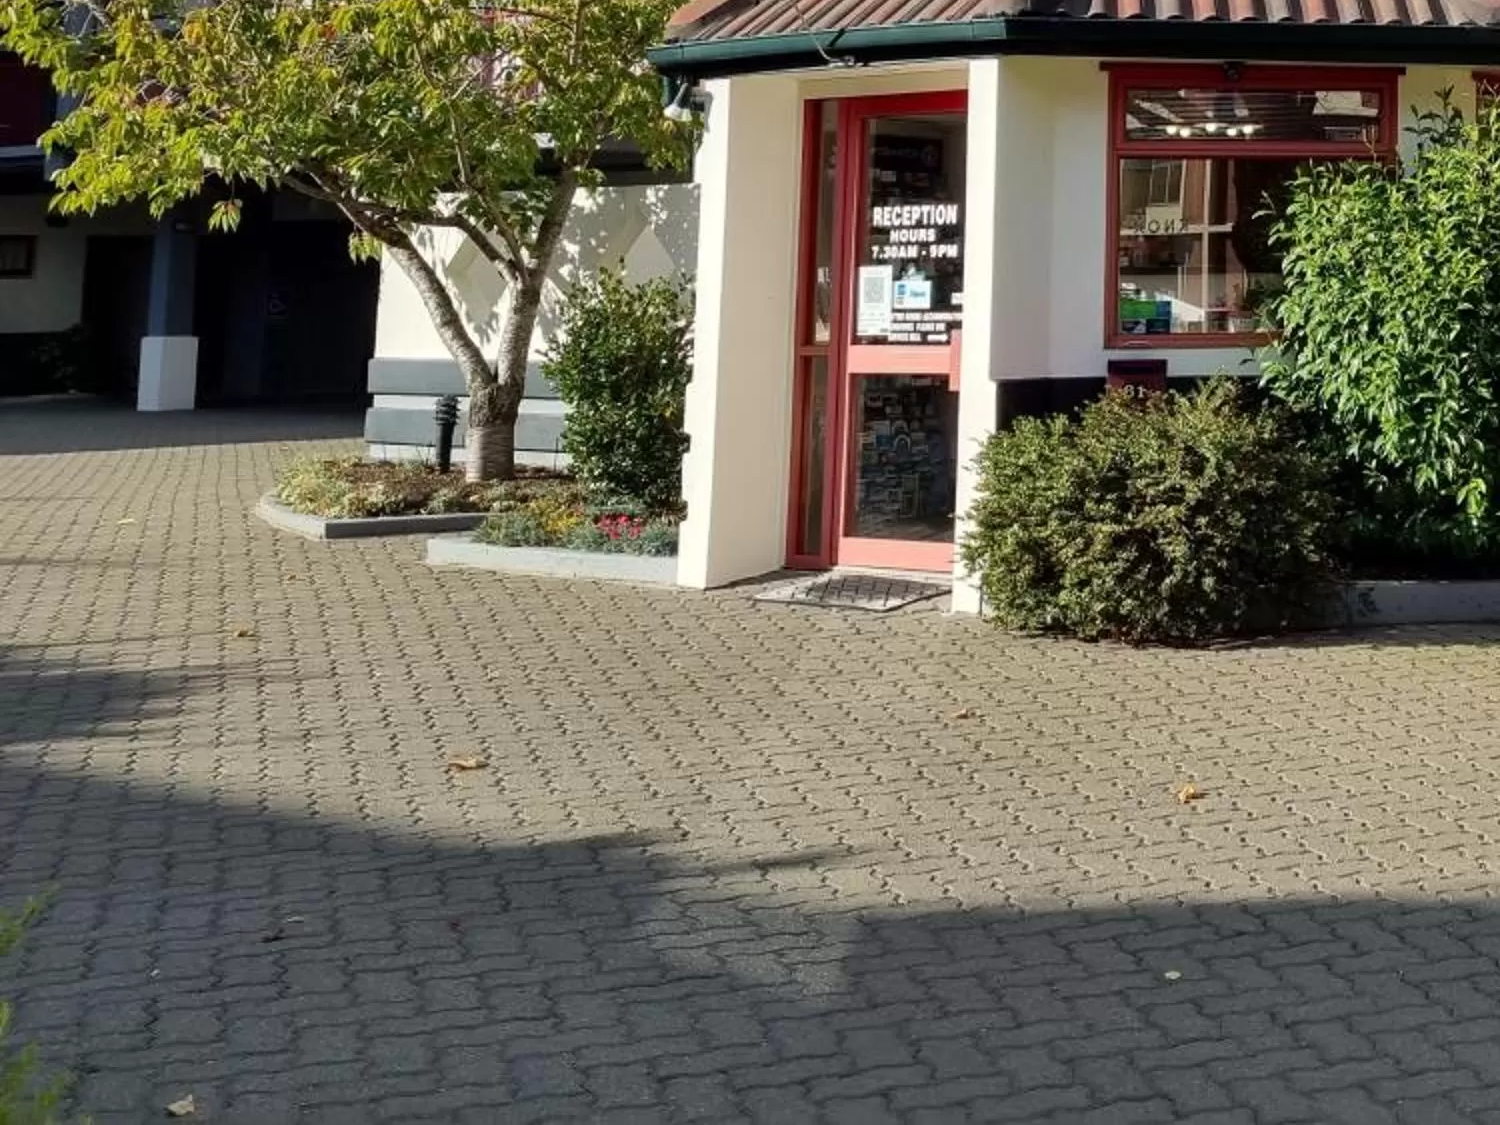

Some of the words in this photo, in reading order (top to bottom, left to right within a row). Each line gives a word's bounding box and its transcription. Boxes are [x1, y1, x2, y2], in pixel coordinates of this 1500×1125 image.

[872, 204, 959, 227] RECEPTION
[889, 229, 936, 244] HOURS
[871, 244, 919, 260] 7.30AM
